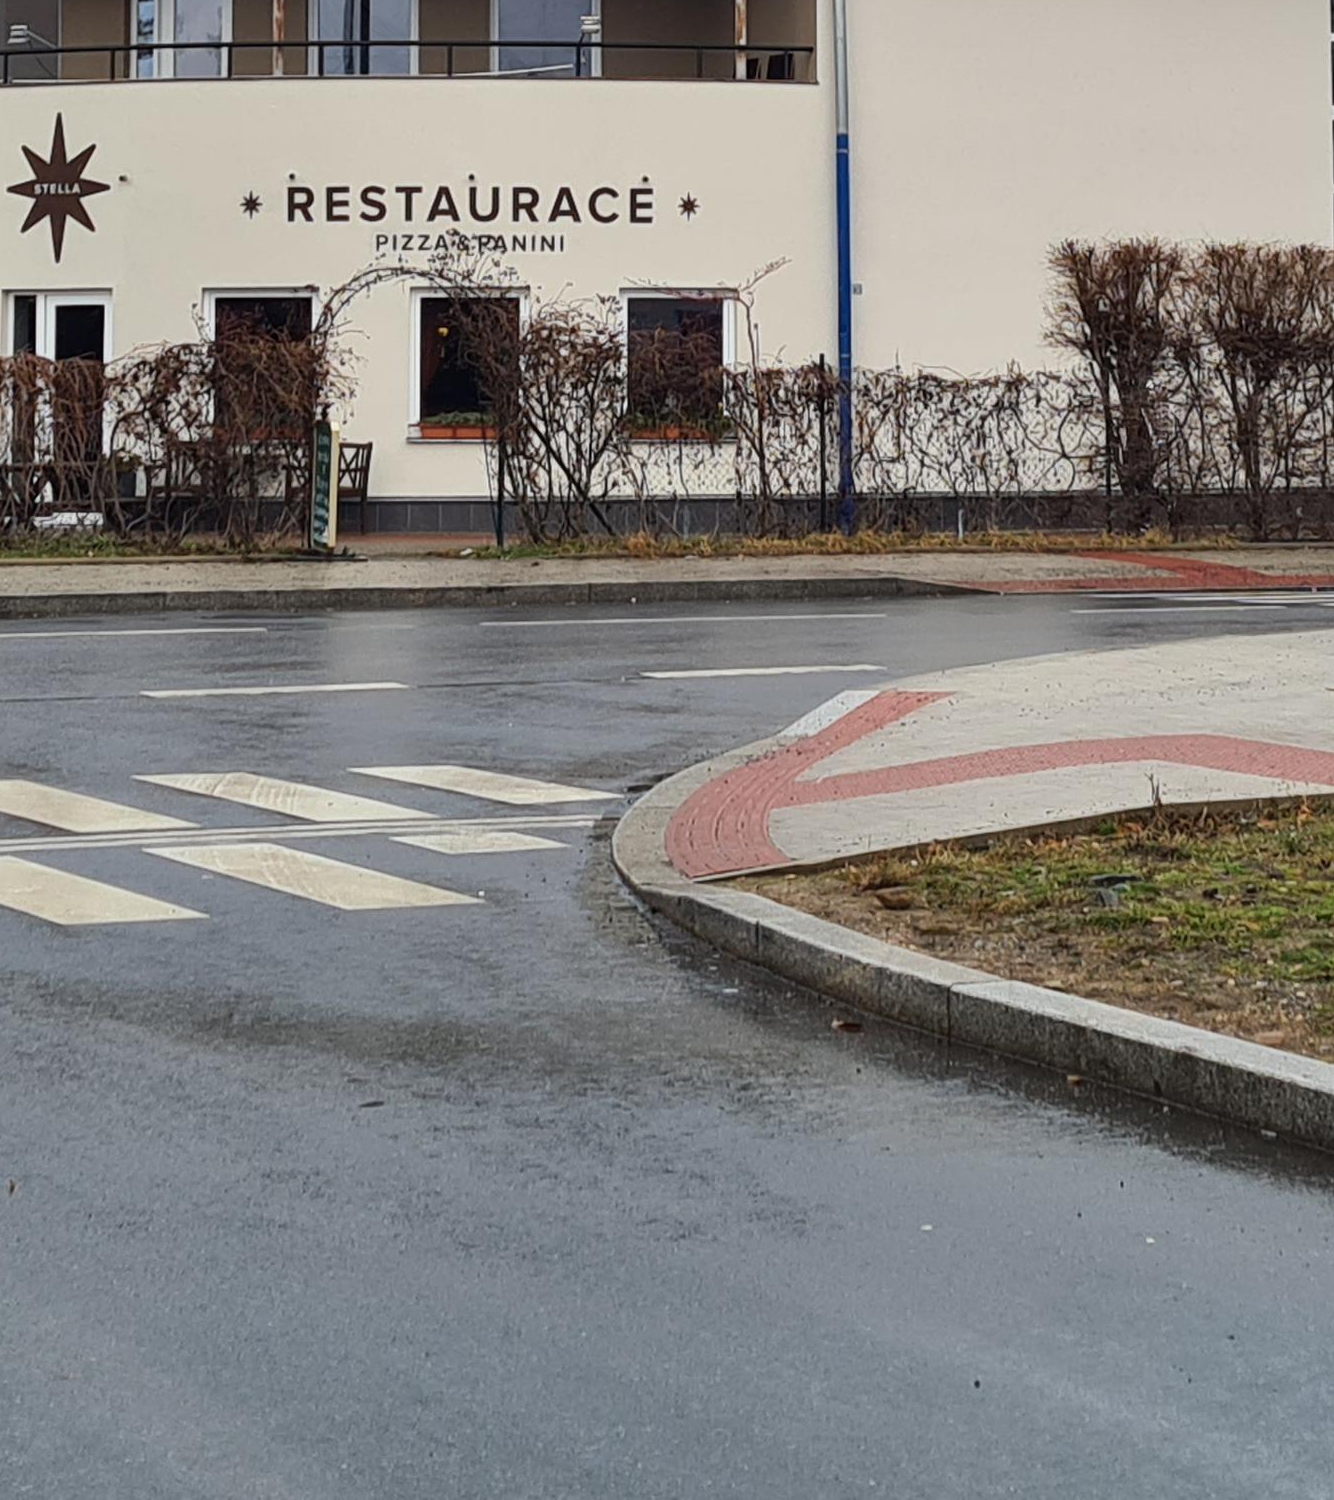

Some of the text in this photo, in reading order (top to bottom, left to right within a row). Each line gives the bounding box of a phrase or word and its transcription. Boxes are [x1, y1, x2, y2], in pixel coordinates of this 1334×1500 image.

[33, 182, 81, 195] STELLA
[287, 185, 655, 224] RESTAURACE
[375, 234, 449, 252] PIZZA
[477, 234, 565, 253] PANINI
